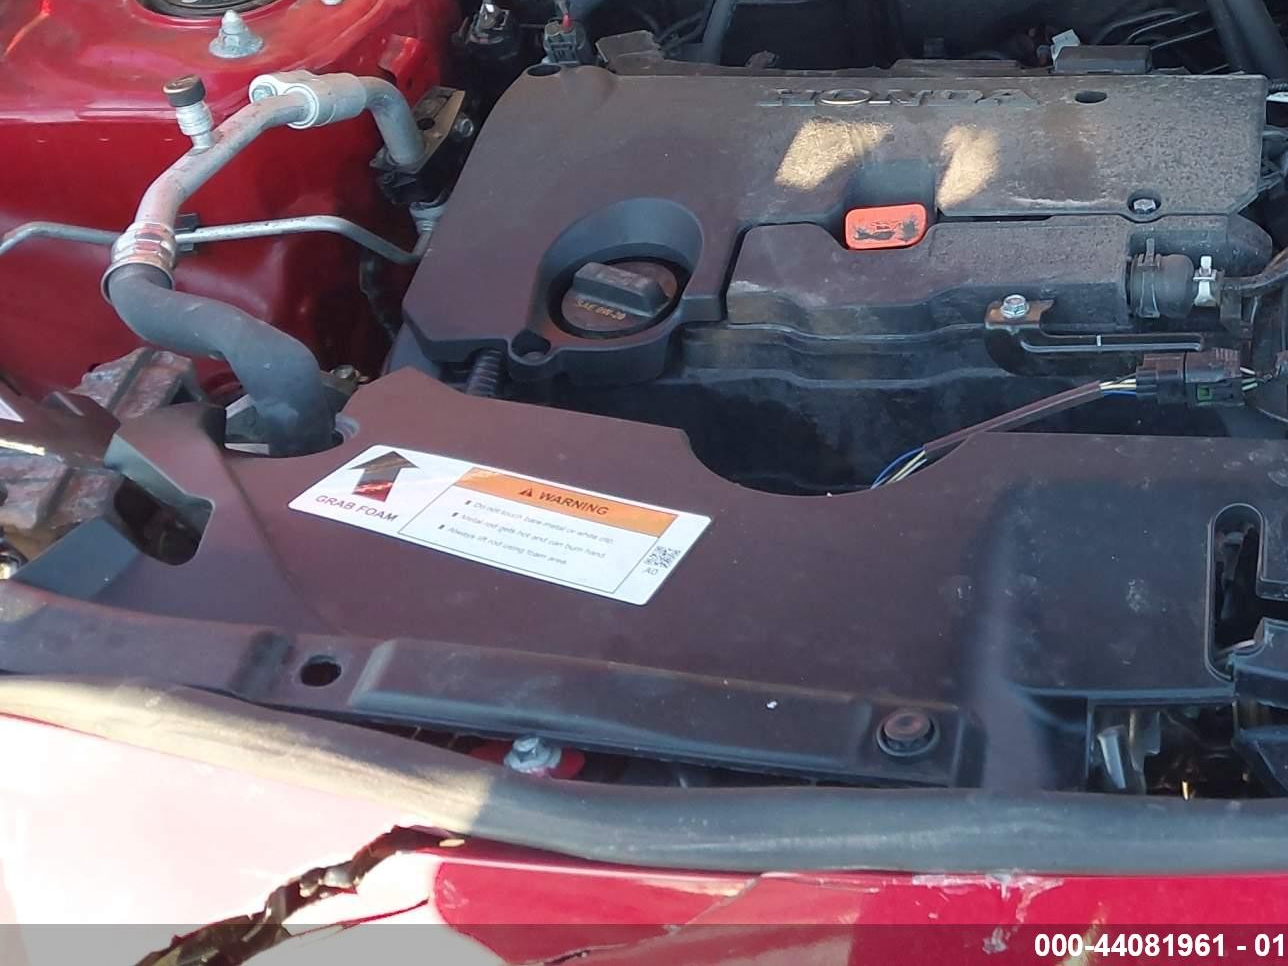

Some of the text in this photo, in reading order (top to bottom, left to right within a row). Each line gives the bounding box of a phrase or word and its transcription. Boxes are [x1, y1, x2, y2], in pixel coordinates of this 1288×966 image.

[315, 495, 398, 521] GRAB FOAM
[539, 492, 609, 515] WARNING
